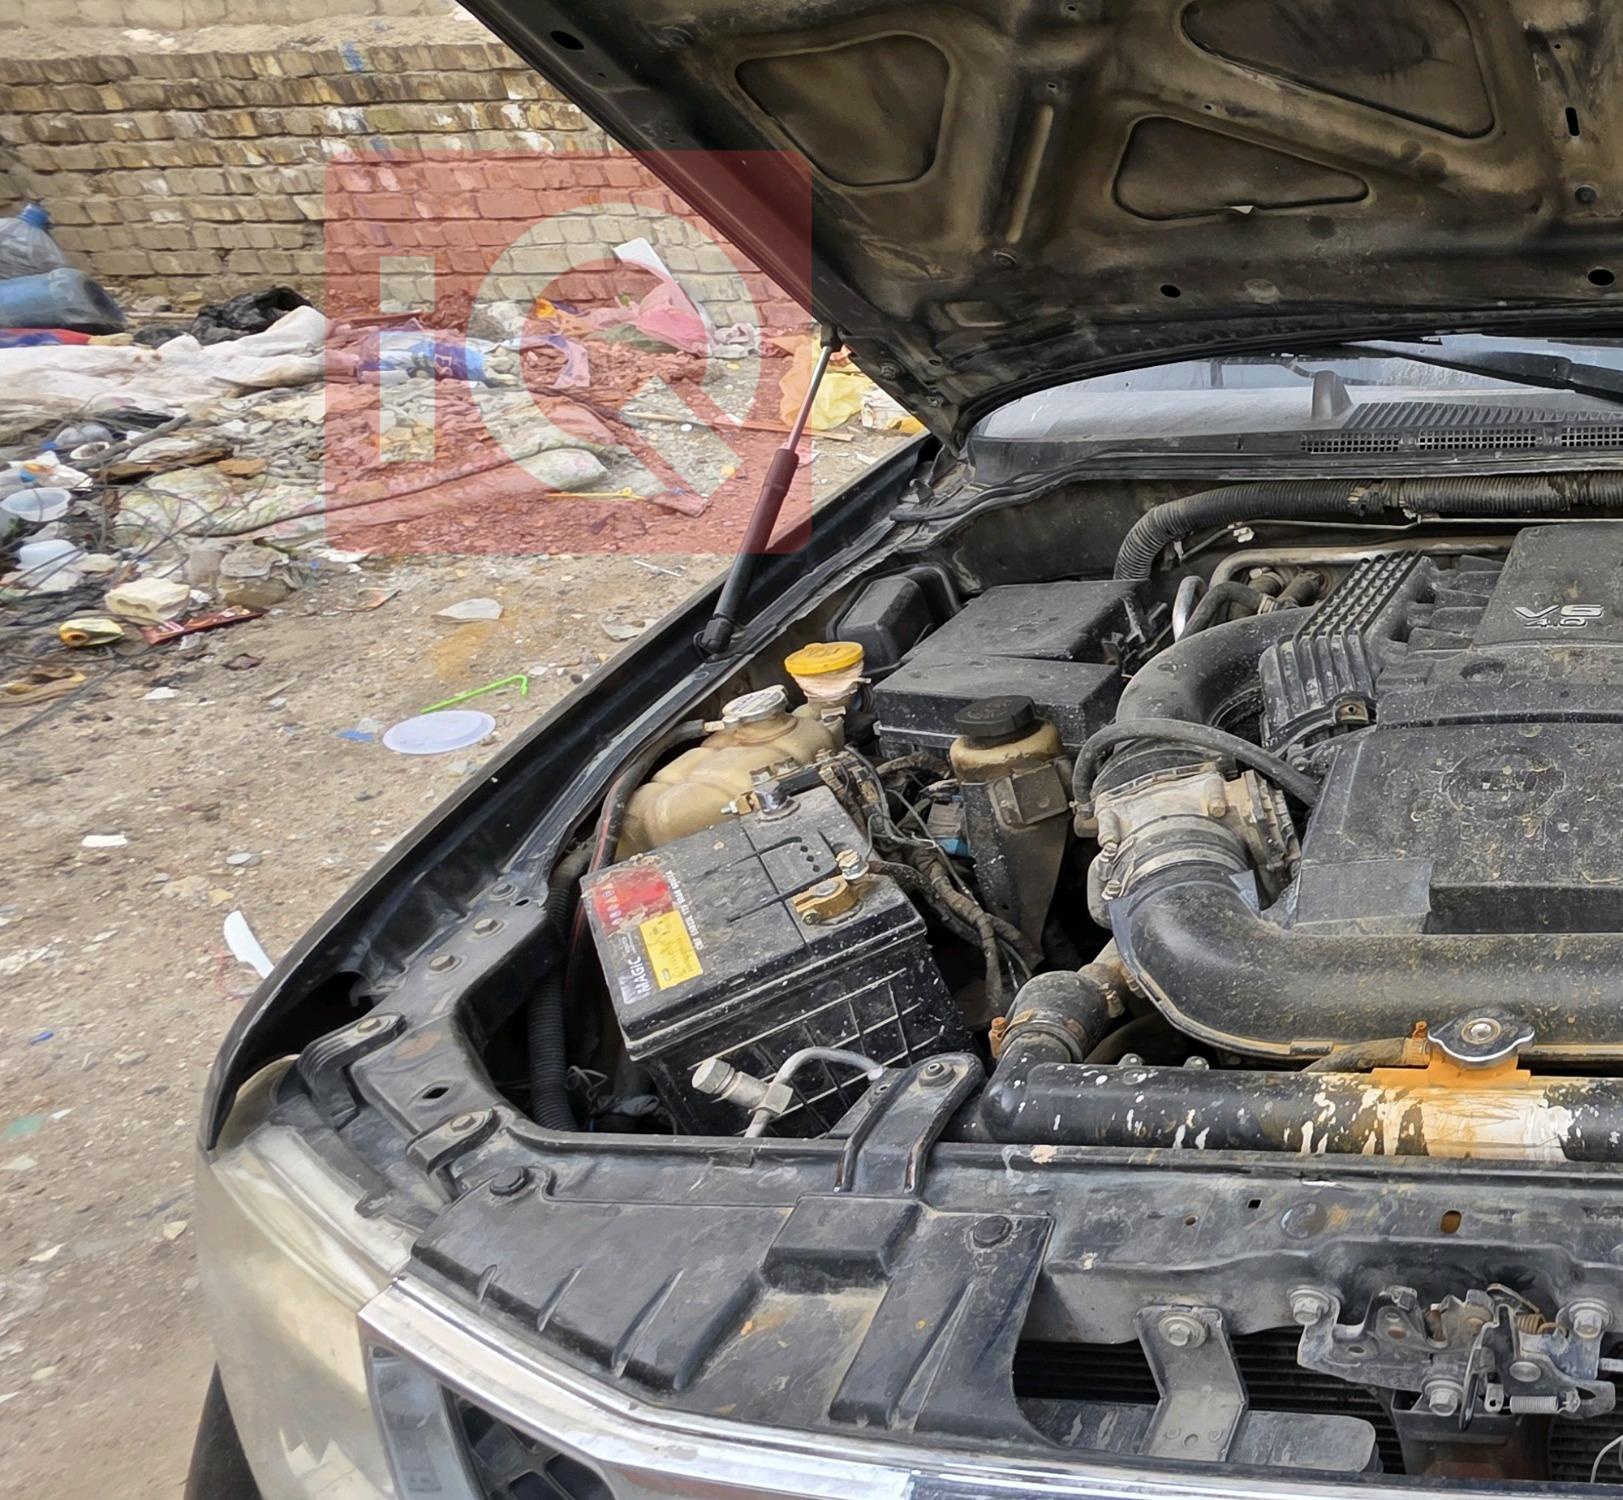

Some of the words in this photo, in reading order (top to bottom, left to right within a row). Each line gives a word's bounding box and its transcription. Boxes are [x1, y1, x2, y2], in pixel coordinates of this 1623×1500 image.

[1512, 604, 1605, 618] V6
[1523, 618, 1588, 628] 4.0
[628, 956, 651, 995] MAGIC
